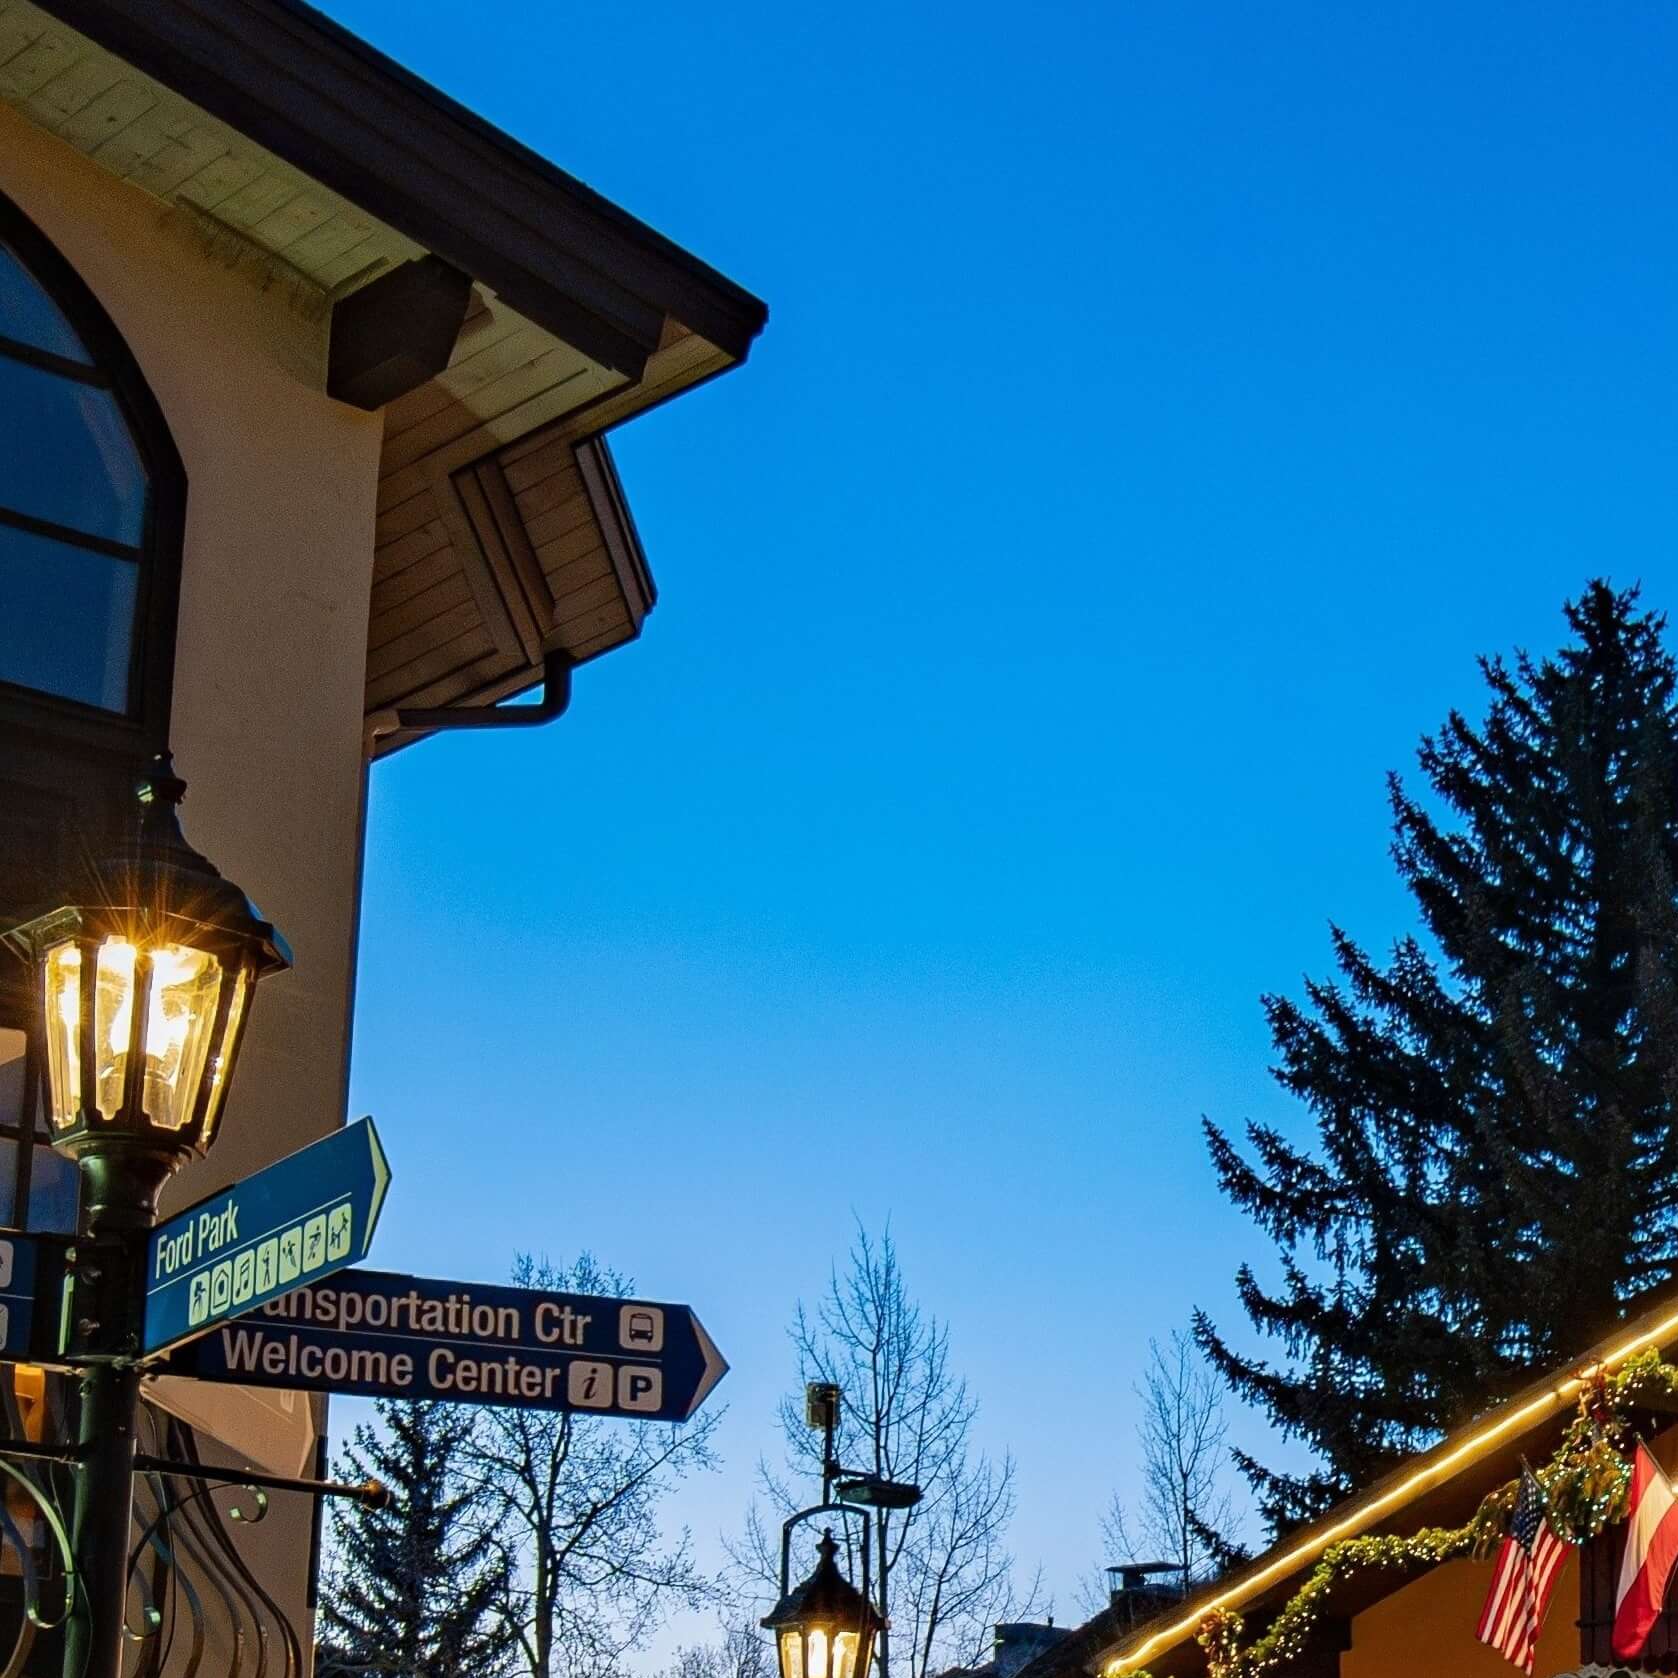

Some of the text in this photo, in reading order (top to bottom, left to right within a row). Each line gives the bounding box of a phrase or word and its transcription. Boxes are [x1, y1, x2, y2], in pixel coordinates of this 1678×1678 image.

[156, 1199, 239, 1279] Ford Park
[262, 1285, 592, 1345] ansportation Ctr
[222, 1328, 414, 1386] Welcome
[428, 1347, 561, 1398] Center
